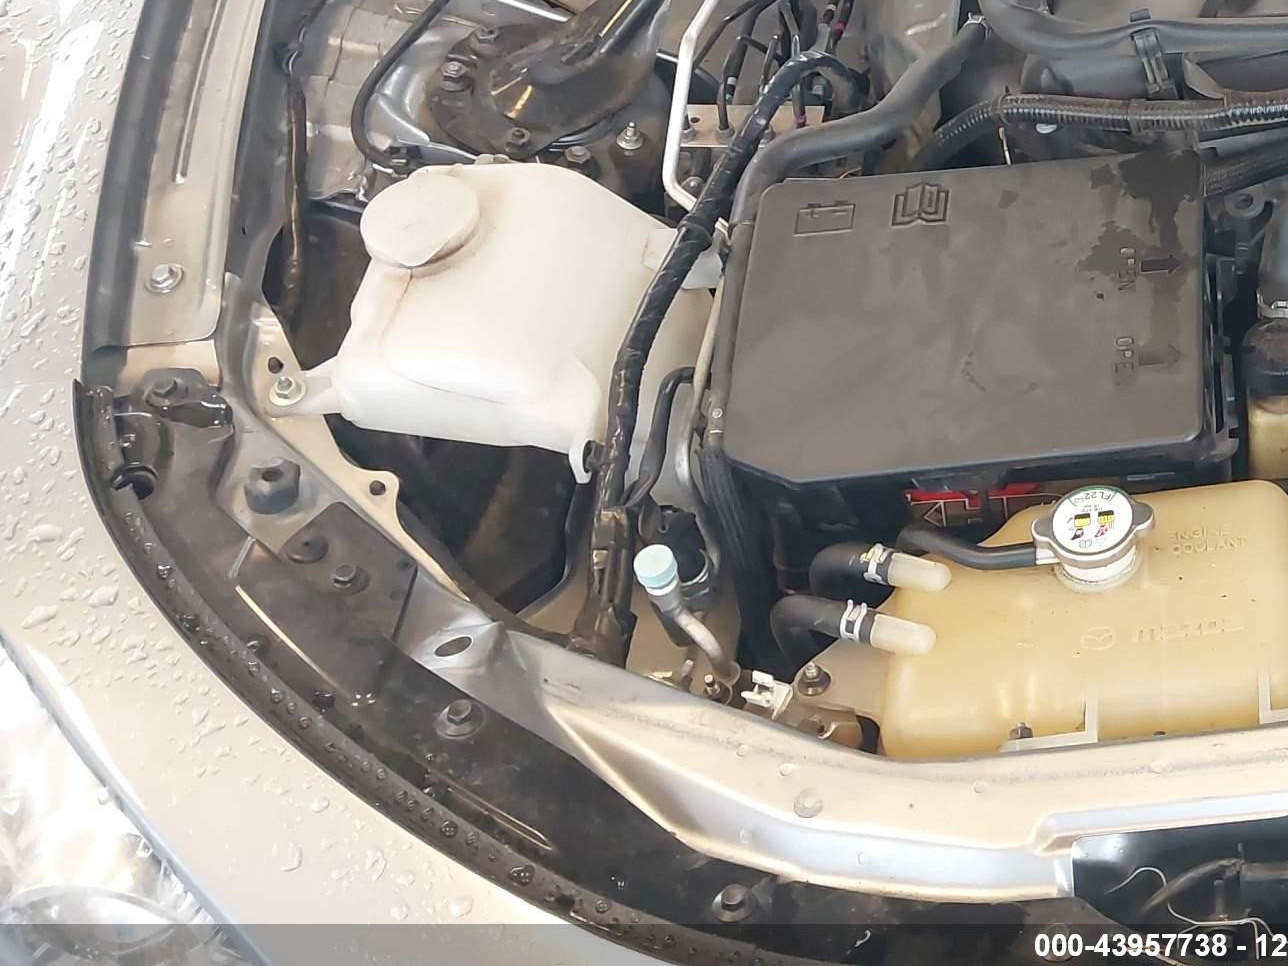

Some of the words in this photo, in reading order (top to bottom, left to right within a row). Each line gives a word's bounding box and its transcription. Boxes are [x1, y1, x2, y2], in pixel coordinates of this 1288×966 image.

[1118, 246, 1136, 291] OPEN
[1114, 336, 1135, 387] OPEN
[1084, 491, 1112, 500] FL22
[1172, 535, 1248, 555] COOLANT
